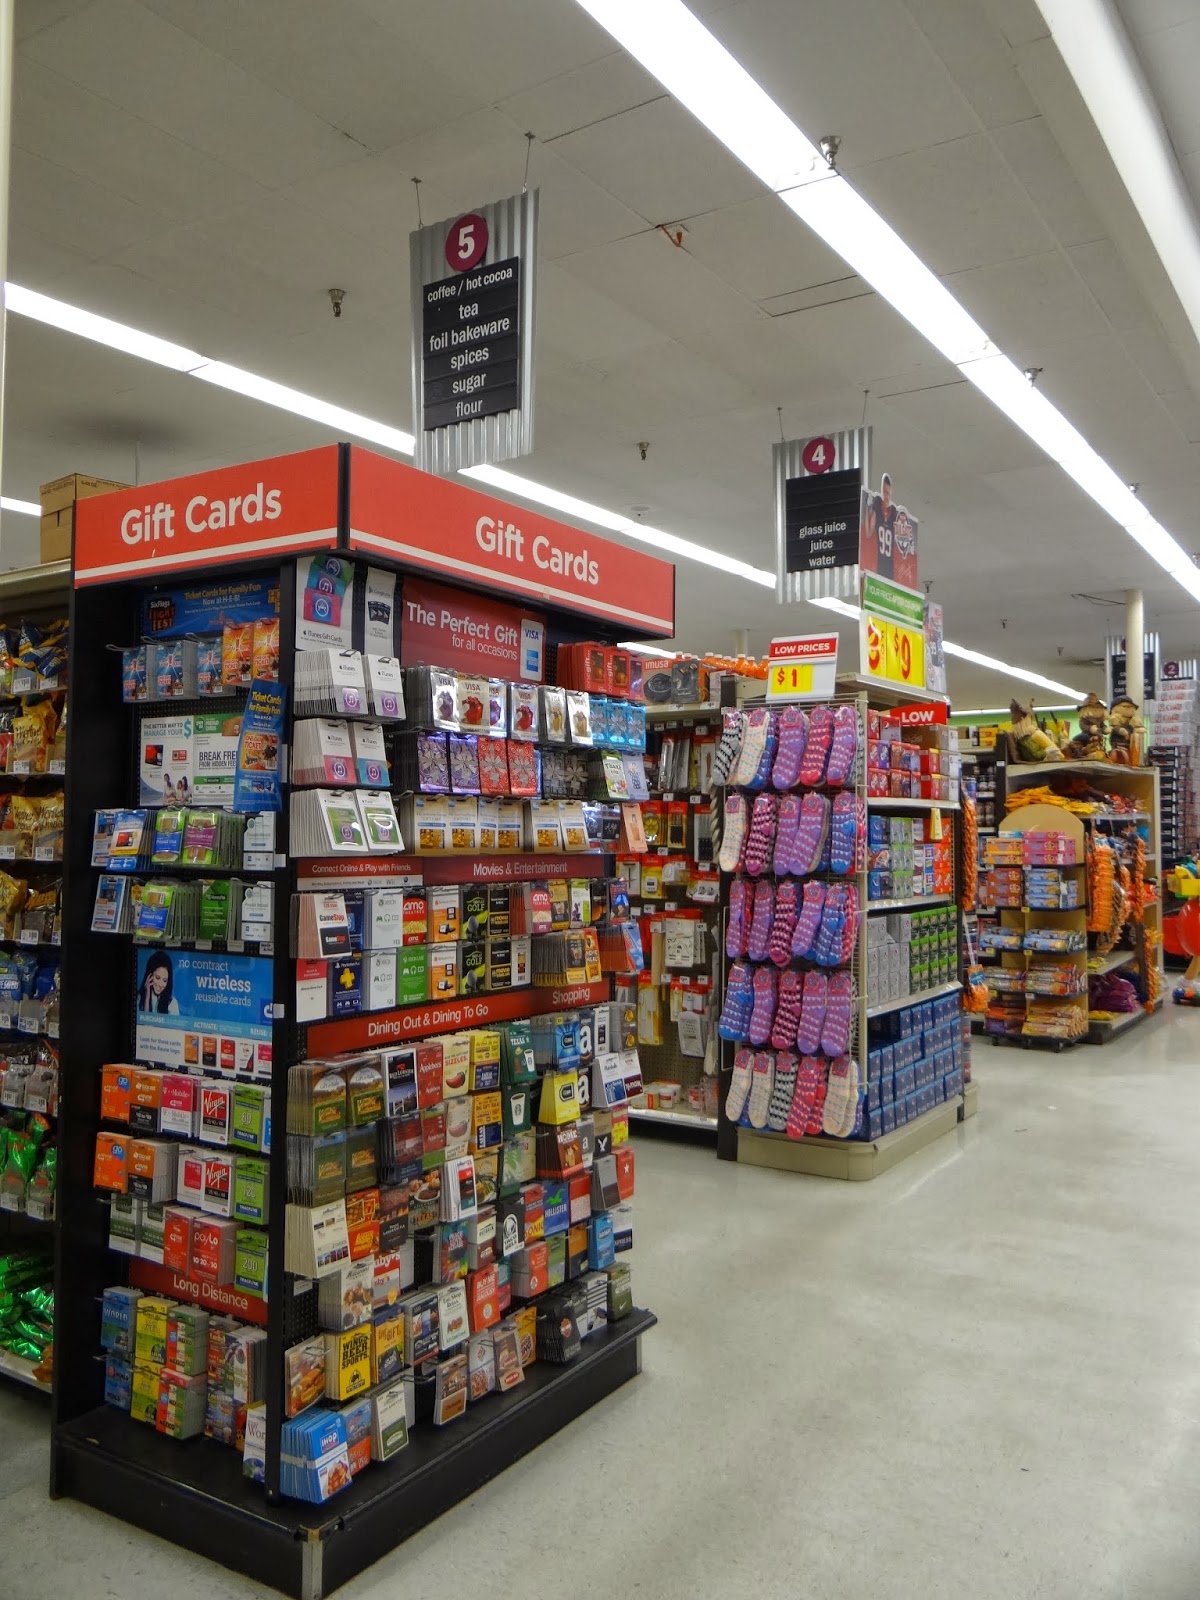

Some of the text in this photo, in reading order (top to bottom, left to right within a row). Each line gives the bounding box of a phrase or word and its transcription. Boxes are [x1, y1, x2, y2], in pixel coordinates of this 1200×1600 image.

[458, 224, 475, 260] 5
[427, 284, 456, 303] coffee
[466, 277, 482, 292] hot
[483, 266, 513, 285] cocoa
[459, 302, 479, 320] tea
[429, 317, 510, 352] foil bakeware
[450, 347, 489, 371] spices
[452, 372, 486, 395] sugar
[455, 399, 483, 417] flour
[811, 444, 826, 466] 4
[120, 481, 282, 546] Gift Cards
[799, 521, 847, 538] glass juice
[809, 539, 833, 553] juice
[878, 526, 892, 557] 99
[475, 515, 600, 586] Gift Cards
[809, 555, 836, 567] water
[201, 589, 219, 598] Cards
[228, 585, 248, 596] Family
[249, 583, 261, 592] Fun
[407, 601, 518, 647] The Perfect Gift
[524, 628, 539, 641] VISA
[452, 634, 518, 661] for all occasions
[774, 642, 830, 655] LOW PRICES
[1168, 664, 1176, 674] 2
[438, 677, 451, 685] VISA
[465, 682, 481, 692] VISA
[518, 692, 531, 700] VISA
[901, 711, 934, 723] LOW
[199, 751, 221, 761] BREAK
[312, 864, 338, 873] Connect
[339, 864, 358, 872] Online
[365, 864, 377, 873] Play
[379, 863, 390, 871] with
[391, 863, 411, 871] Friends
[473, 861, 568, 876] Movies & Entertainment
[403, 901, 424, 910] amc
[467, 904, 485, 912] GOLF
[319, 914, 345, 922] GameStop
[178, 959, 229, 972] no contract
[466, 958, 483, 966] GOLF
[196, 975, 251, 993] wireless
[195, 993, 252, 1007] reusable cards
[552, 987, 591, 1005] Shopping
[194, 1022, 218, 1031] ACTIVATE:
[368, 1003, 489, 1037] Dining Out & Dining To Go
[250, 1028, 268, 1037] REUSE:
[510, 1038, 525, 1046] TEXAS
[203, 1093, 225, 1116] Virgin
[557, 1129, 577, 1143] HOME
[206, 1162, 227, 1188] Virgin
[545, 1203, 567, 1217] HOLLISTER
[477, 1276, 487, 1288] BUY
[173, 1274, 248, 1310] Long Distance
[104, 1308, 128, 1321] WORLD
[169, 1358, 185, 1367] MEXICO
[160, 1420, 175, 1431] MEXICO
